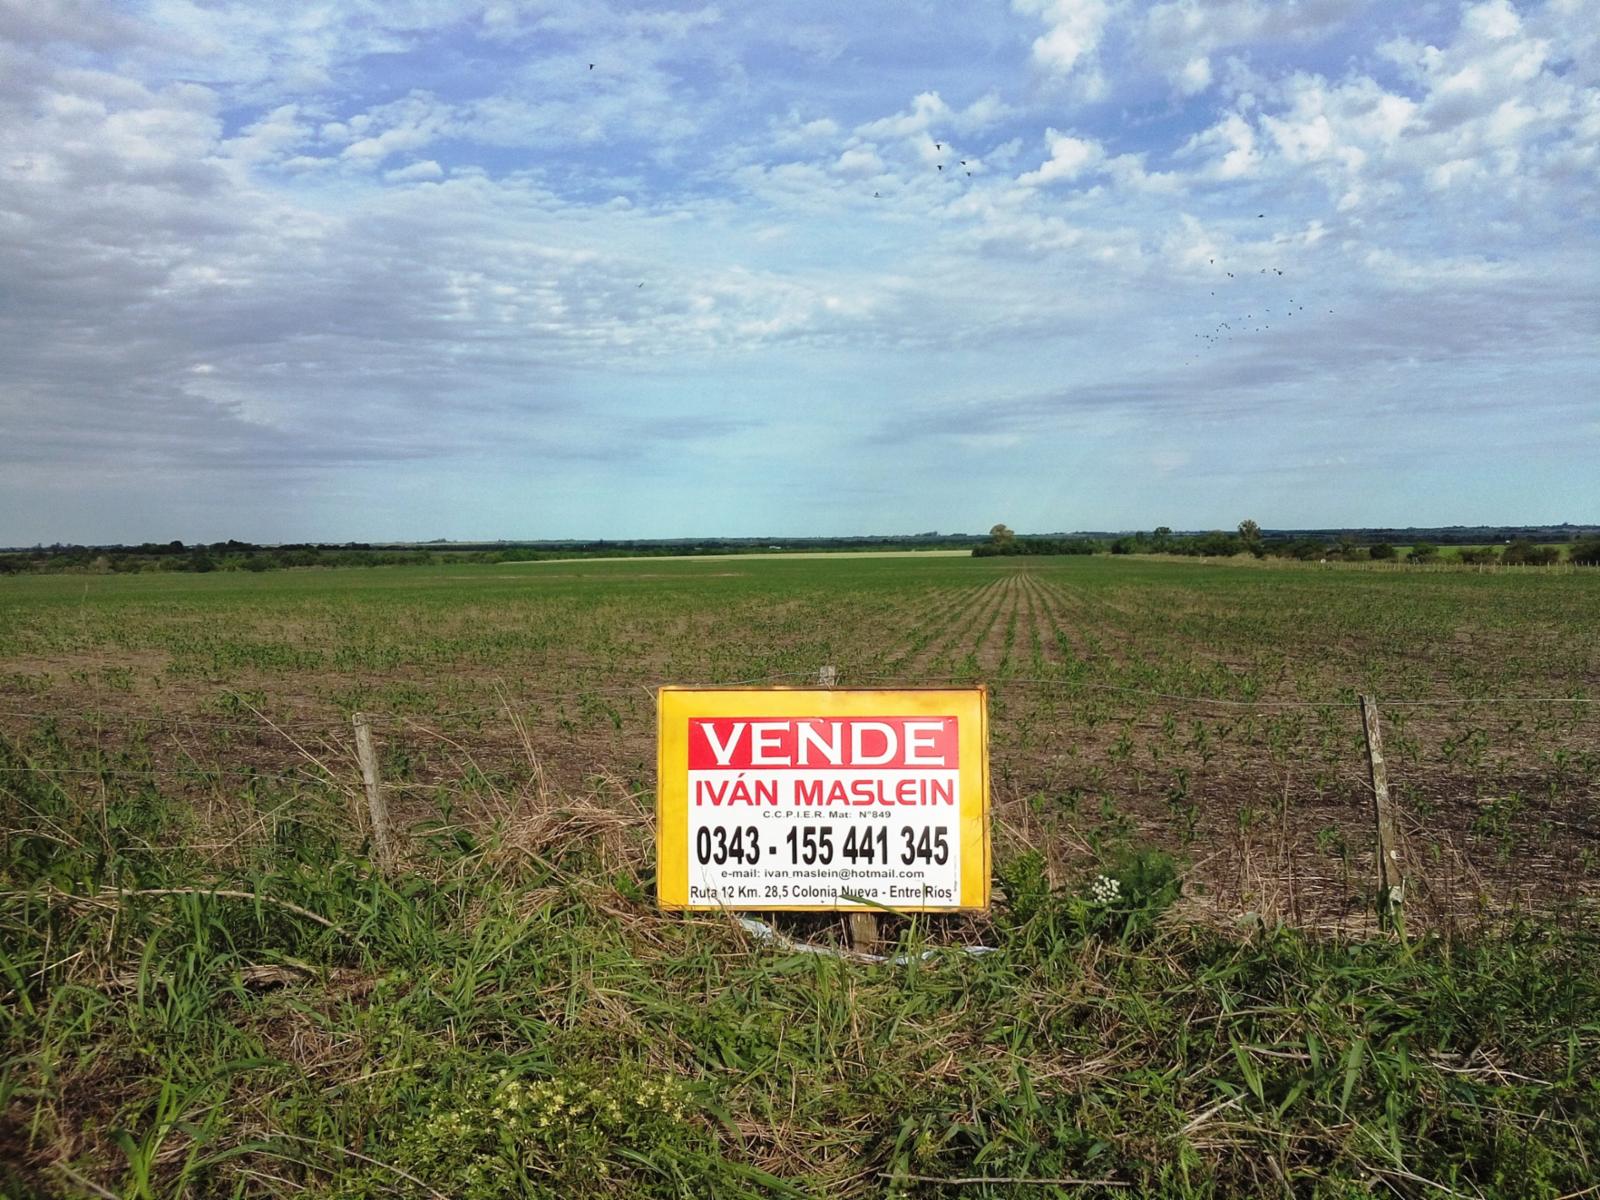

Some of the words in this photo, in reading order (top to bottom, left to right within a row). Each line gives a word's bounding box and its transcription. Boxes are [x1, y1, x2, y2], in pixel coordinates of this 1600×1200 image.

[700, 720, 945, 767] VENDE
[695, 772, 778, 806] IVÁN
[794, 779, 954, 806] MASLEIN
[762, 810, 826, 819] C.C.P.I.E.R.
[696, 825, 760, 865] 0343
[786, 825, 834, 865] 155
[842, 825, 889, 865] 441
[900, 825, 949, 866] 345
[721, 869, 761, 878] e-mail:
[764, 869, 925, 880] ivan_maslein@hotmail.com
[690, 886, 718, 899] Ruta
[722, 886, 735, 899] 12
[738, 886, 761, 899] Km.
[764, 886, 789, 900] 28,5
[792, 885, 838, 898] Colonia
[841, 885, 879, 898] Nueva
[889, 885, 922, 898] Entre
